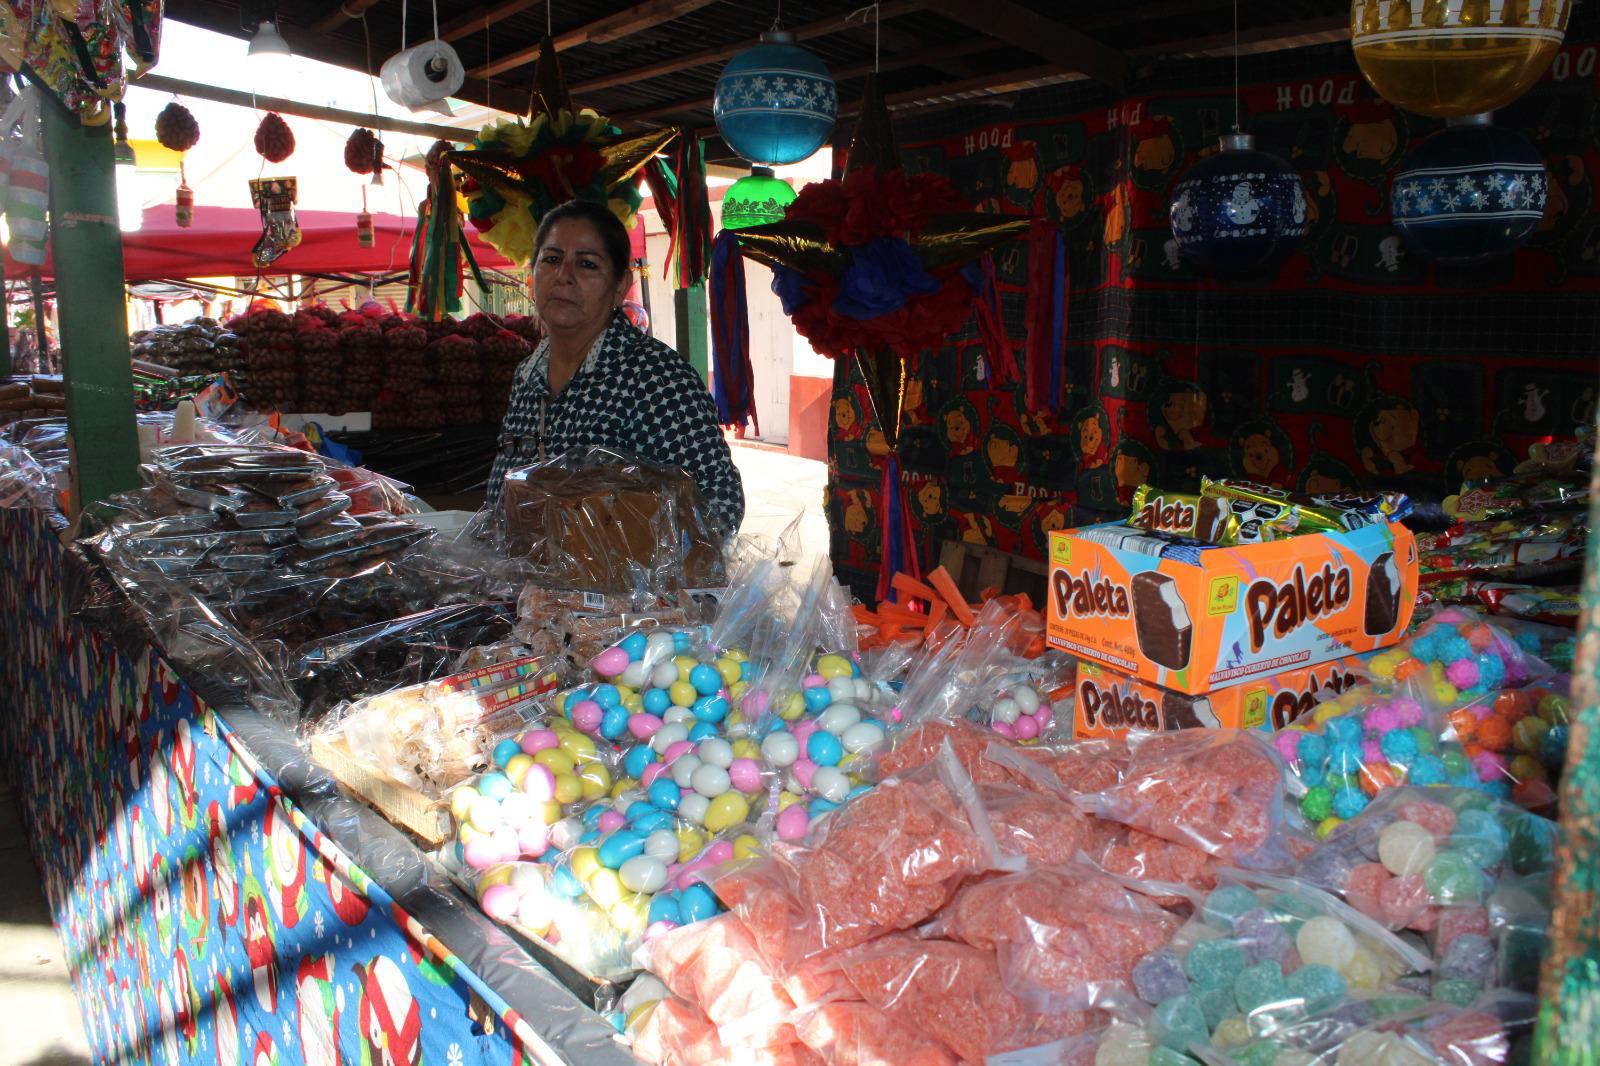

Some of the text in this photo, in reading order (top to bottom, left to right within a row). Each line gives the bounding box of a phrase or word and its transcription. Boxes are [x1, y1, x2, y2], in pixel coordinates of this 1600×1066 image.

[1052, 568, 1131, 620] Paleta
[1245, 561, 1352, 654] Paleta
[1080, 679, 1160, 731] Paleta
